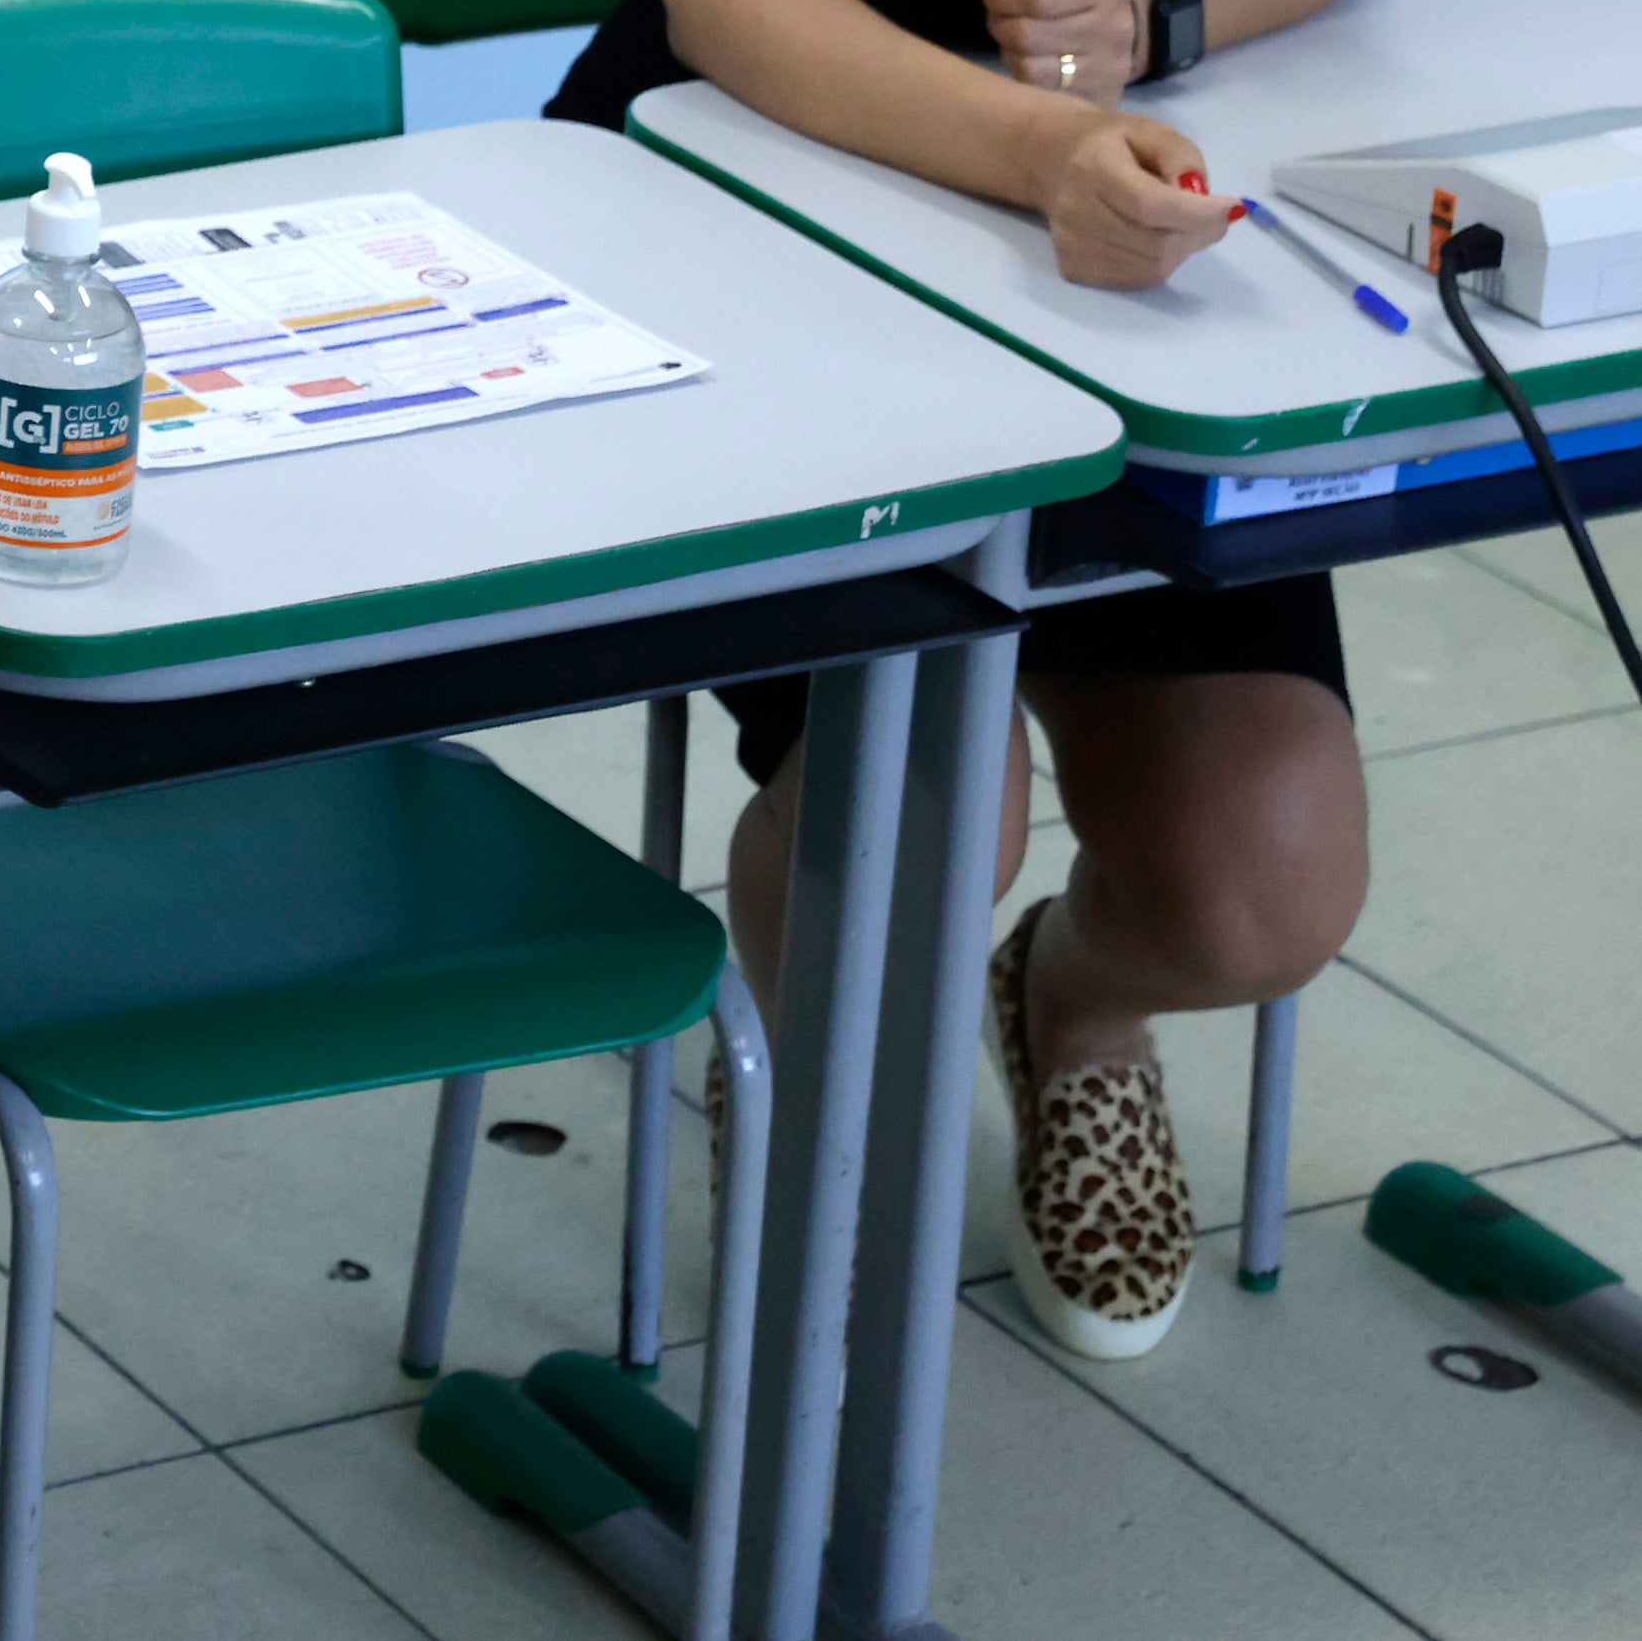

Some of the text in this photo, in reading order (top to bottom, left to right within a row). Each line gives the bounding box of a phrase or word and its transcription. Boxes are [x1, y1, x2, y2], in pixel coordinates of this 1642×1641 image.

[65, 401, 120, 422] CICLO
[63, 414, 129, 440] GEL 70
